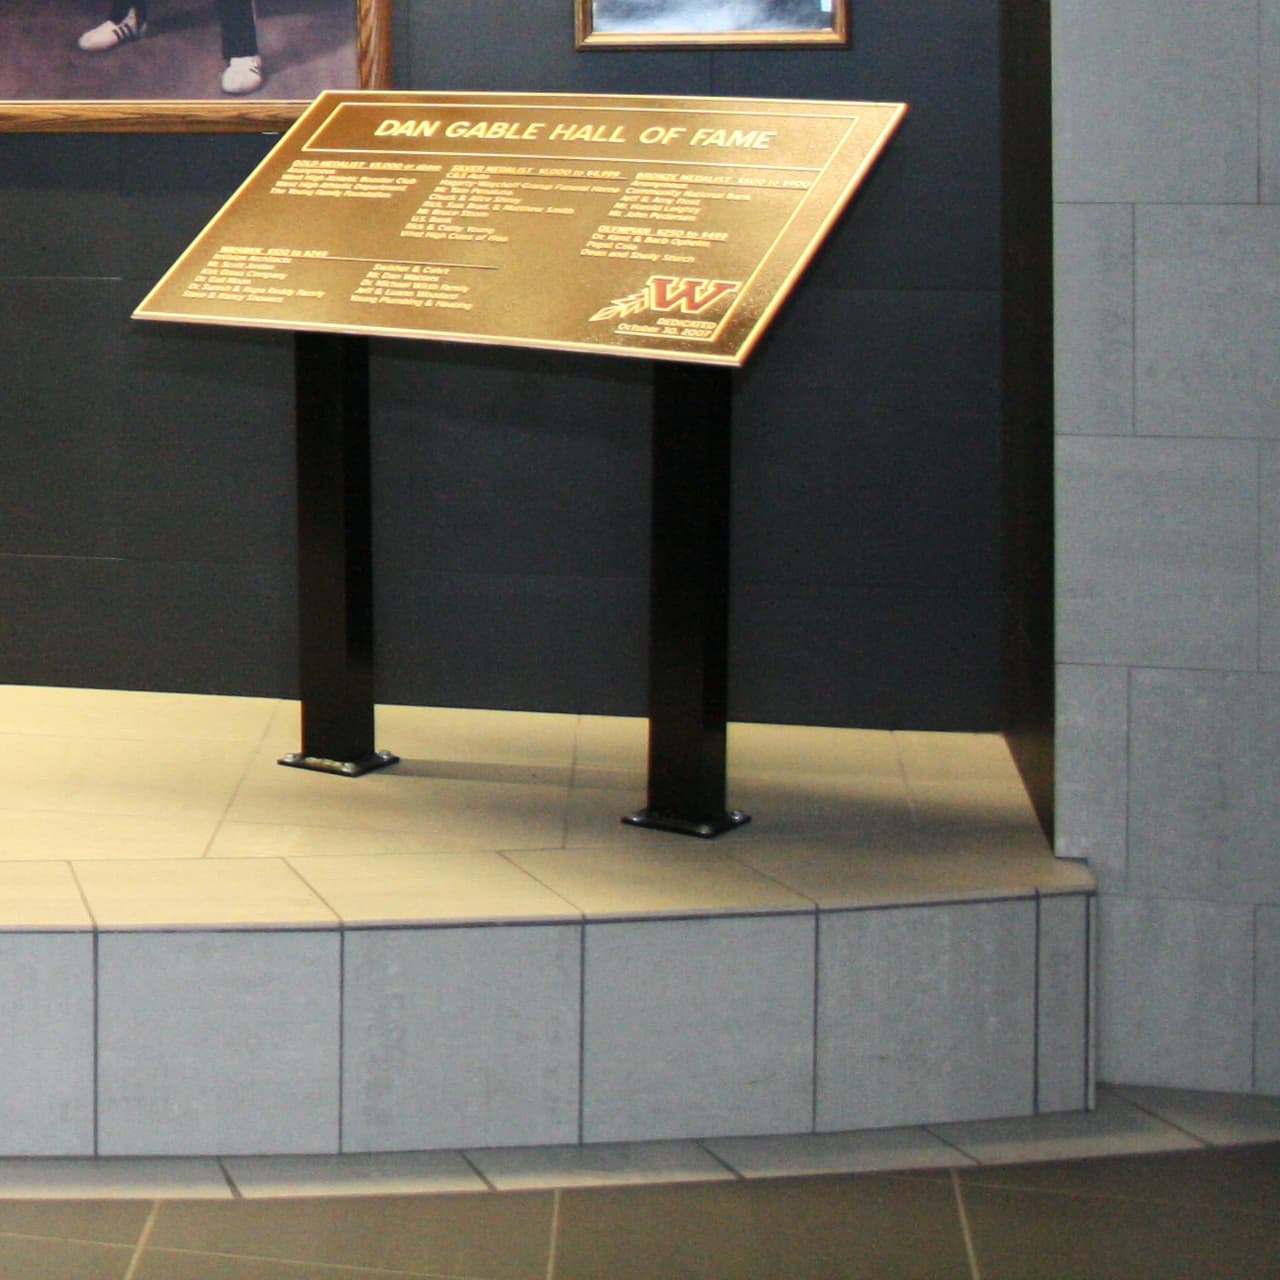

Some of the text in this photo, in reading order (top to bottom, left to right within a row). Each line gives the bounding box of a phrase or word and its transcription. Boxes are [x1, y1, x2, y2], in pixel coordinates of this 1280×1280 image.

[374, 119, 777, 149] DAN GABLE HALL OF FAME
[618, 323, 660, 334] October
[681, 328, 713, 338] 2007
[656, 318, 717, 329] DEDICATED
